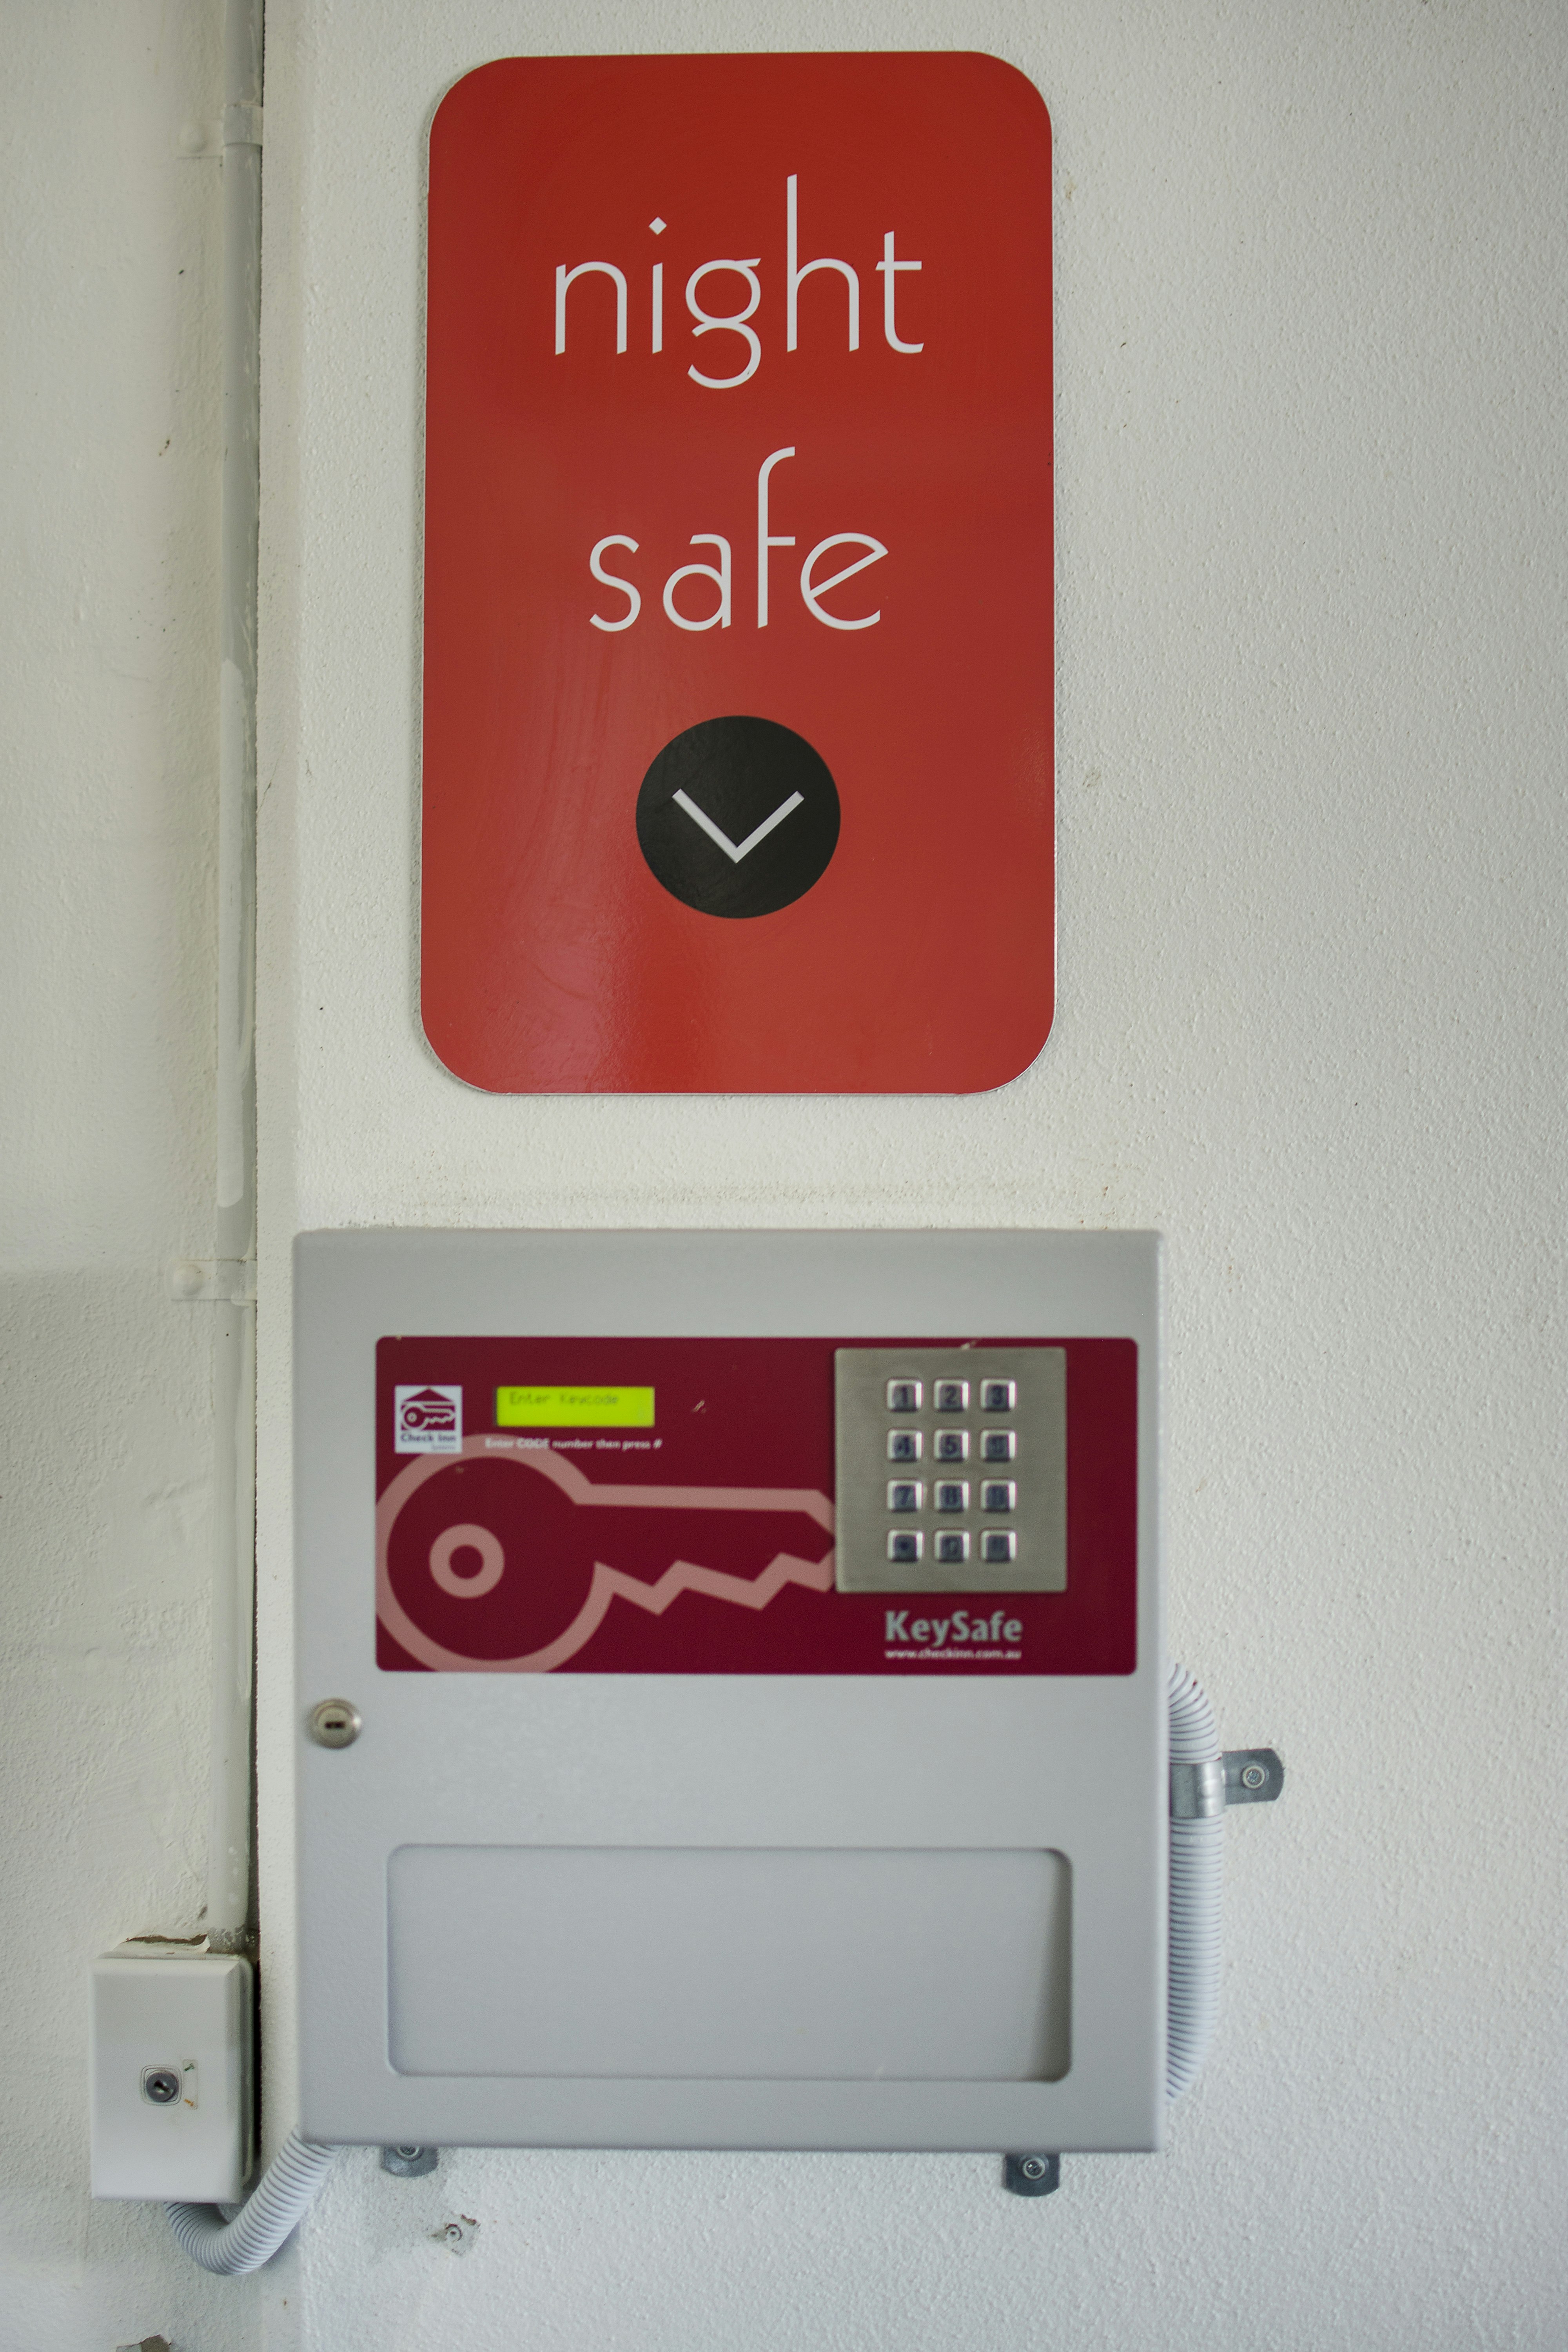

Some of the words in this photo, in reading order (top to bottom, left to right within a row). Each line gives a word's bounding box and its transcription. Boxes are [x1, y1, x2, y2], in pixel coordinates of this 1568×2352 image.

[555, 174, 924, 389] night
[589, 446, 889, 632] safe
[510, 1391, 550, 1405] Enter
[899, 1385, 908, 1405] 1
[945, 1385, 957, 1405] 2
[401, 1433, 434, 1443] Check
[485, 1438, 514, 1448] Enter
[516, 1438, 550, 1449] CODE
[552, 1438, 593, 1449] number
[596, 1438, 621, 1449] then
[622, 1440, 651, 1452] press
[945, 1435, 957, 1455] 5
[885, 1610, 1023, 1648] KeySafe
